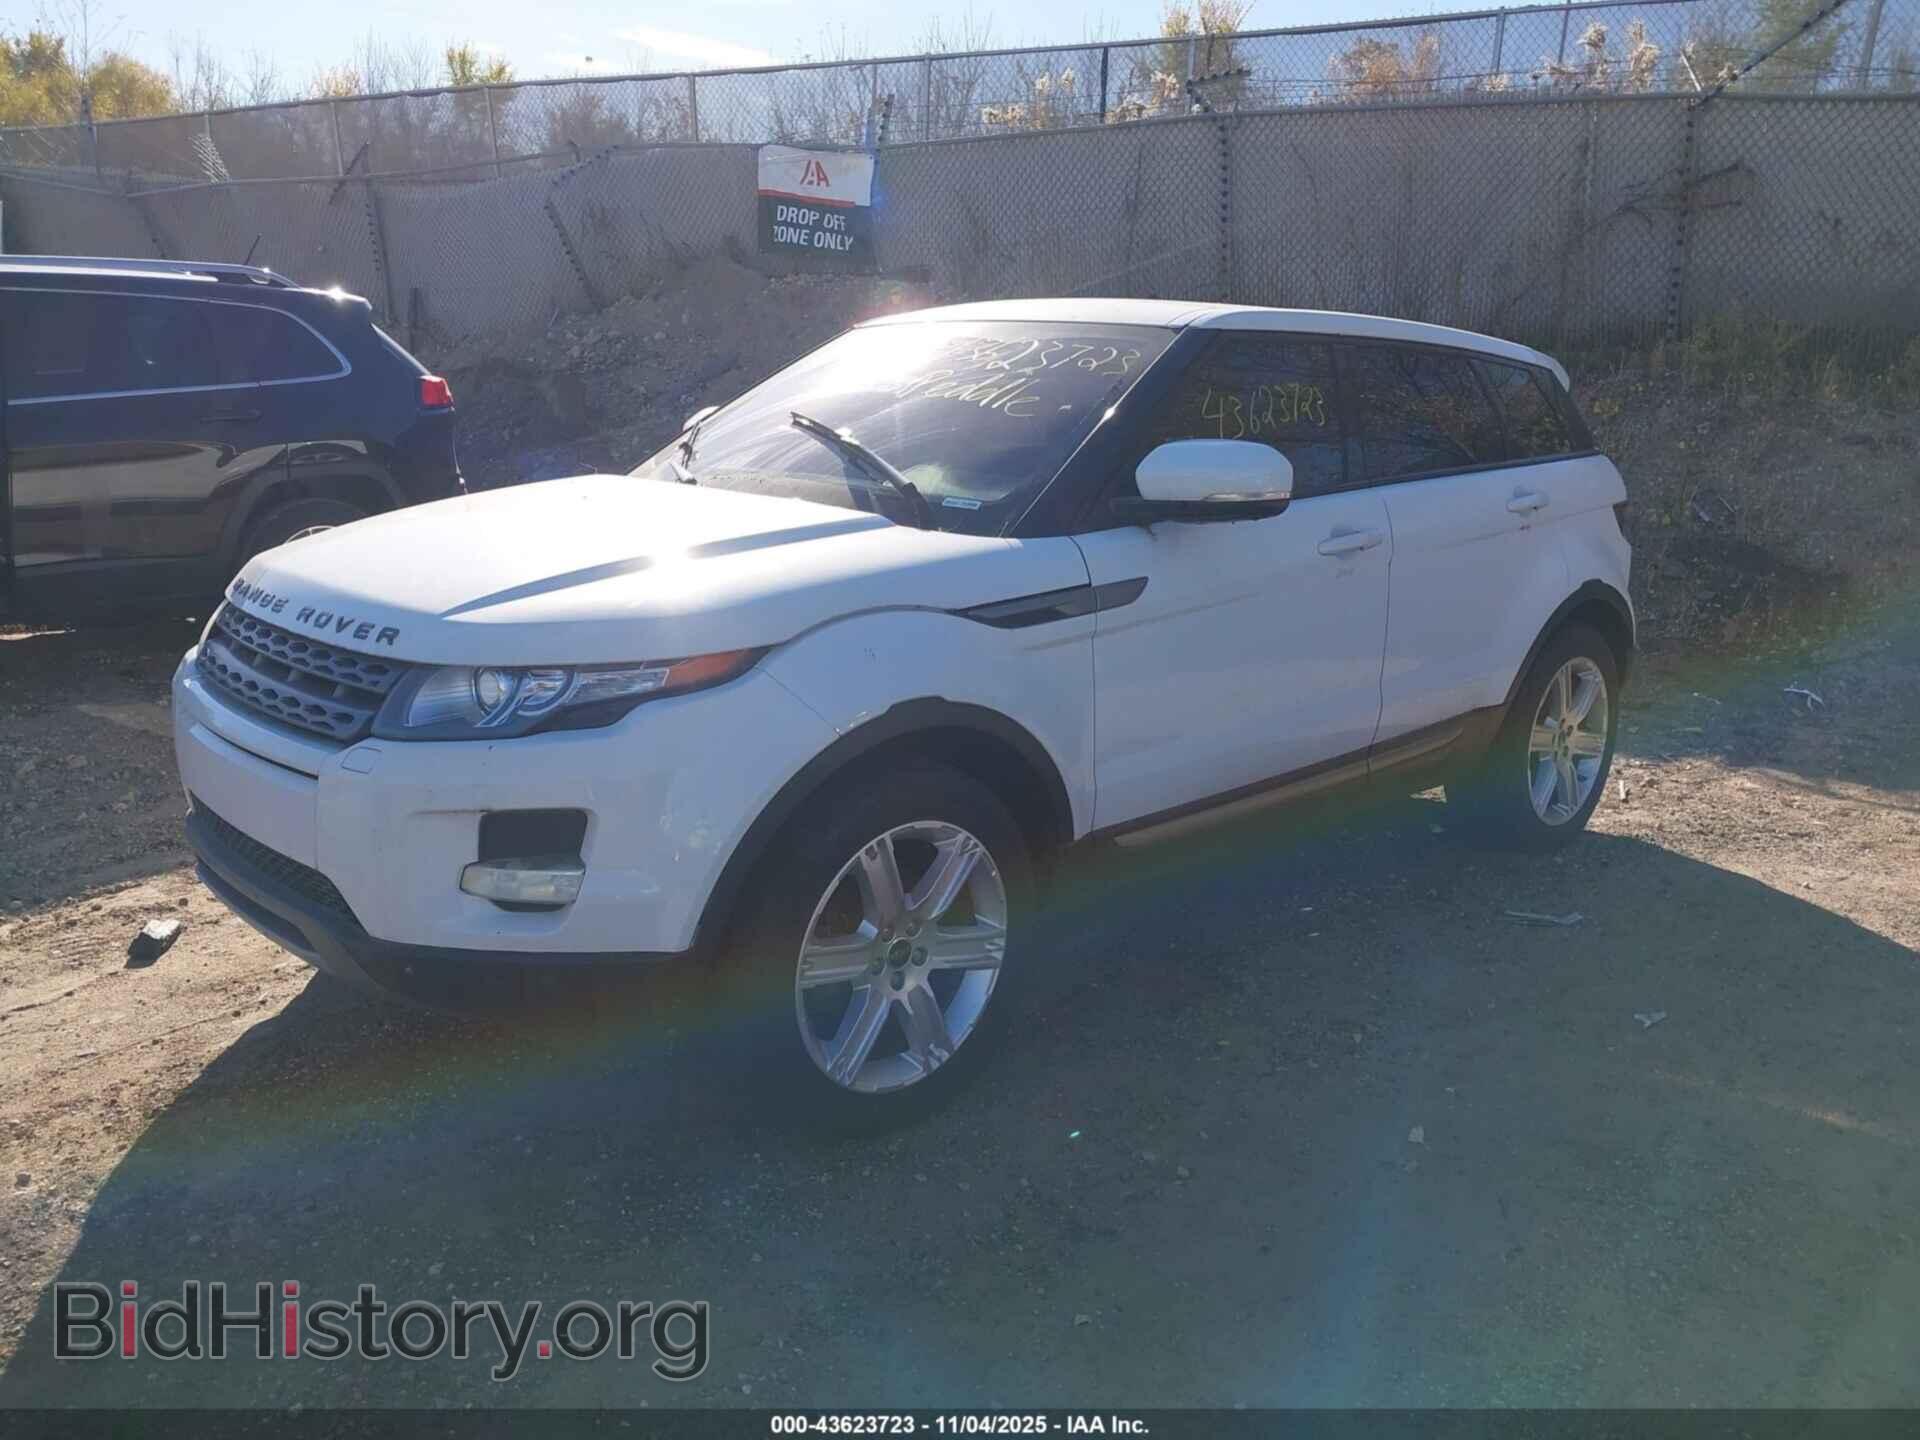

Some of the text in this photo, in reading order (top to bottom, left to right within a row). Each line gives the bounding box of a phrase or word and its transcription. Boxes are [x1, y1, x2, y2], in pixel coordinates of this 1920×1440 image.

[776, 205, 846, 231] DROP OFF
[814, 231, 854, 251] ONLY
[1201, 383, 1326, 439] 43623723
[232, 577, 400, 646] RANGE ROVER
